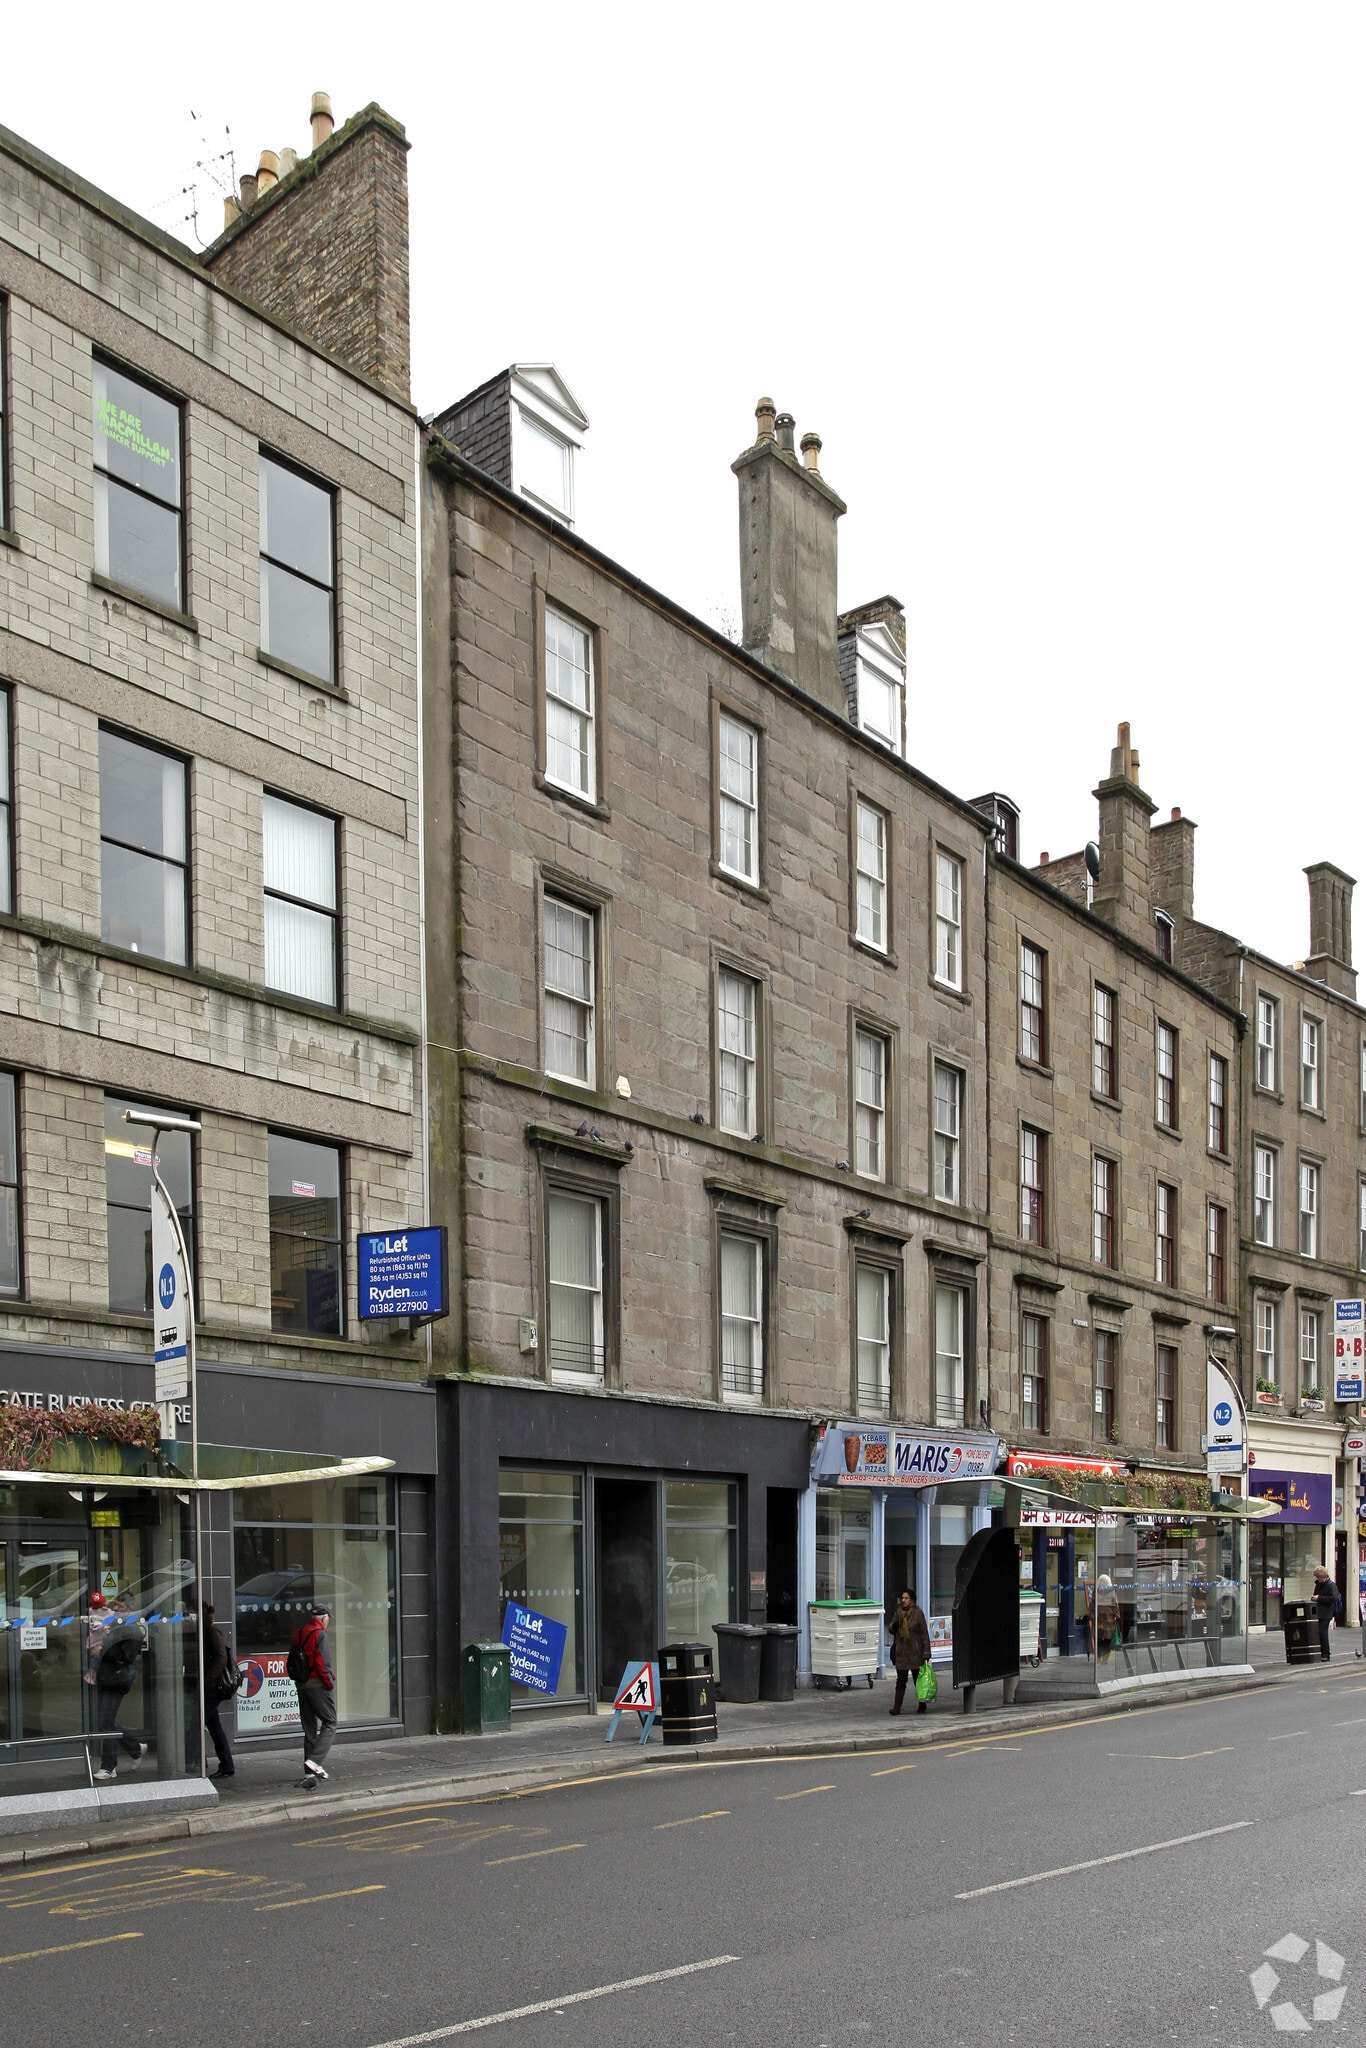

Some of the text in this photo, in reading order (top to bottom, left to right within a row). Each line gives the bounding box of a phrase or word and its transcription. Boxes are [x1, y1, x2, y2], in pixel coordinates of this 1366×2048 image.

[98, 396, 142, 431] WE ARE
[98, 424, 166, 467] CANCER SUPPORT
[369, 1256, 400, 1264] Refurbished
[401, 1254, 416, 1262] Office
[160, 1276, 174, 1297] N.1
[370, 1301, 428, 1314] 01382 227900
[1336, 1338, 1344, 1357] B
[1354, 1338, 1362, 1357] B
[130, 1401, 191, 1423] CERE
[1215, 1409, 1230, 1419] N.2
[862, 1434, 887, 1442] KEBABS
[895, 1443, 950, 1473] MARIS
[967, 1462, 984, 1472] 01382
[901, 1475, 928, 1484] BURGERS
[1020, 1511, 1038, 1523] SH
[1043, 1512, 1051, 1523] &
[1056, 1512, 1086, 1524] PIZZA
[267, 1661, 284, 1674] FOR
[510, 1667, 547, 1690] 382 227900
[271, 1701, 299, 1710] CONSEN
[263, 1715, 281, 1723] 01382
